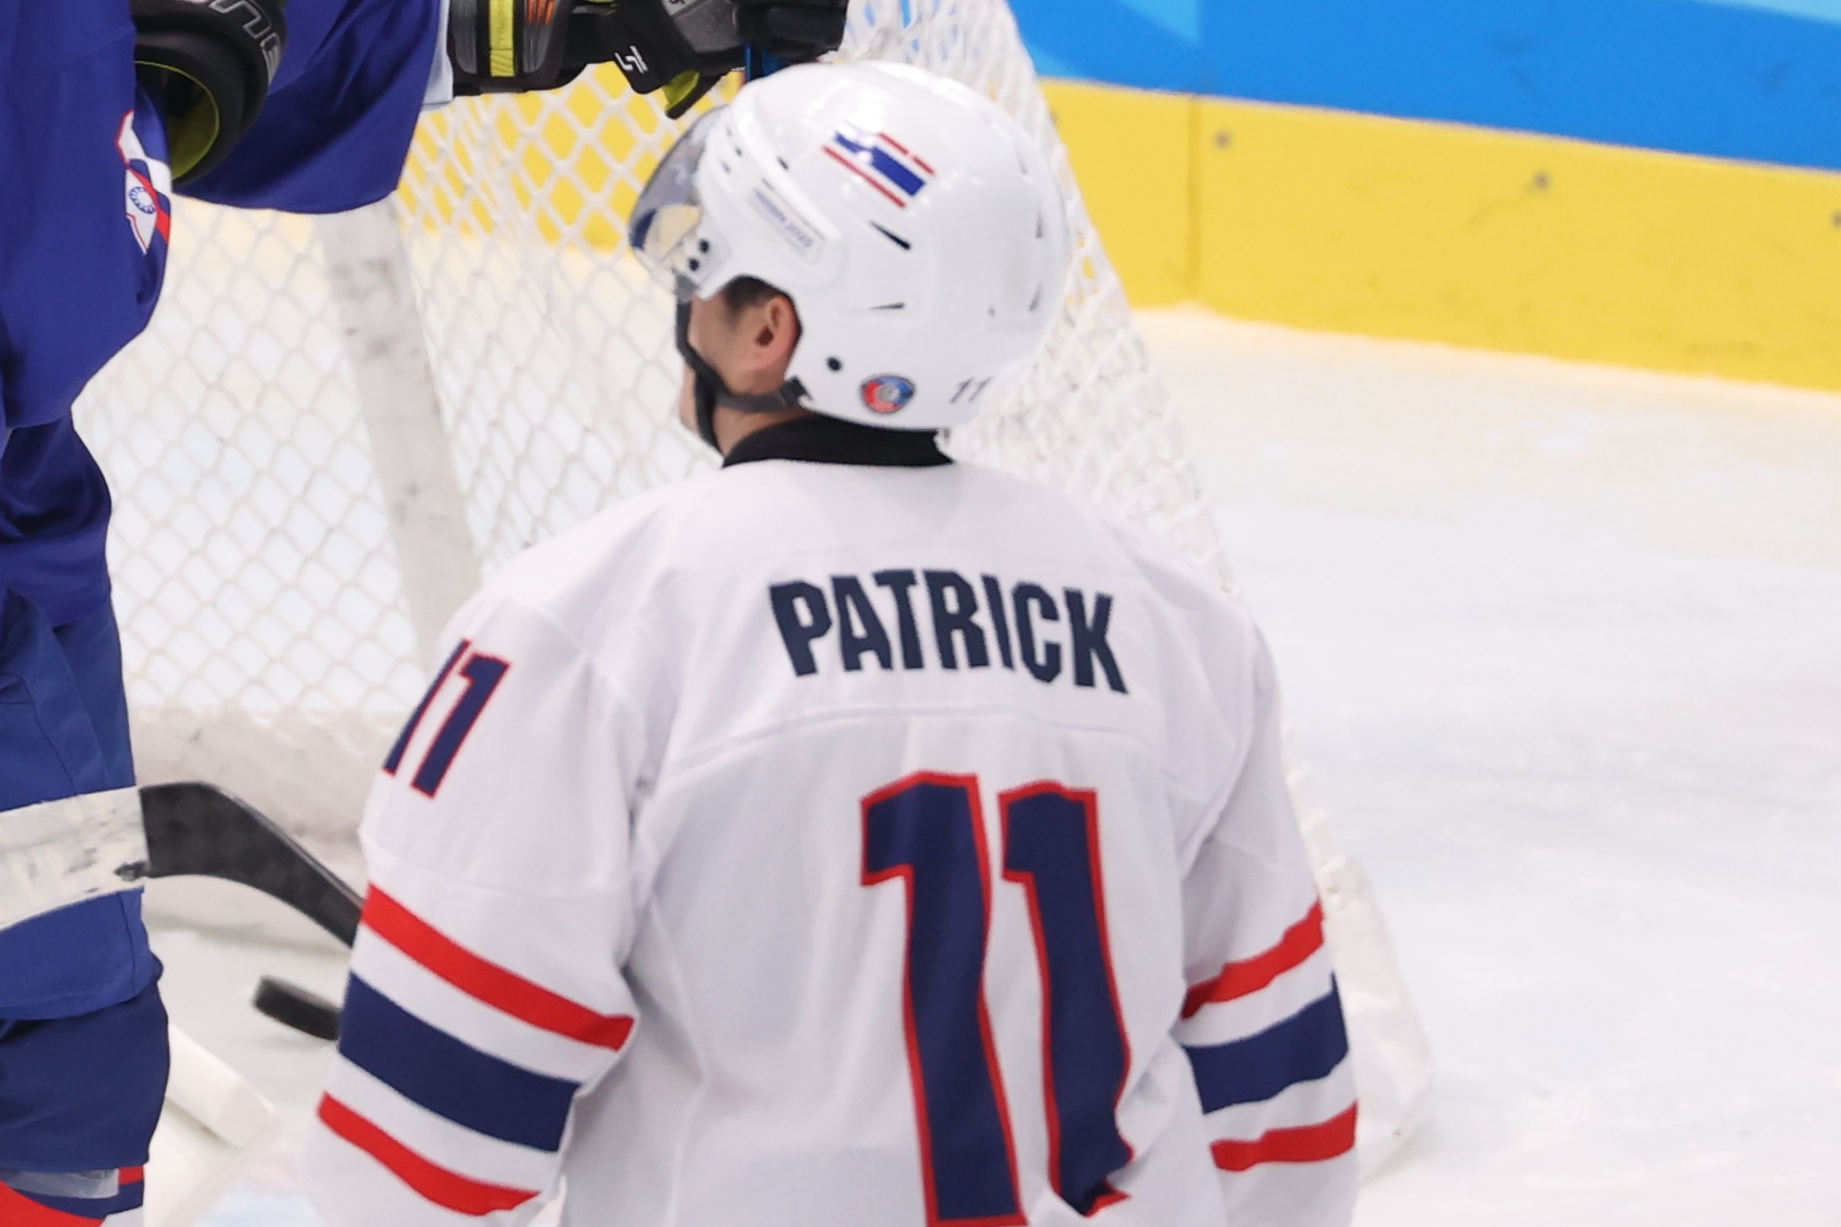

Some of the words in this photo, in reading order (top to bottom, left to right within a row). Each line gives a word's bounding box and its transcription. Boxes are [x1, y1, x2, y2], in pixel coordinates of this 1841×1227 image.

[769, 568, 1128, 695] PATRICK
[381, 639, 510, 799] 11
[859, 769, 1133, 1227] 11
